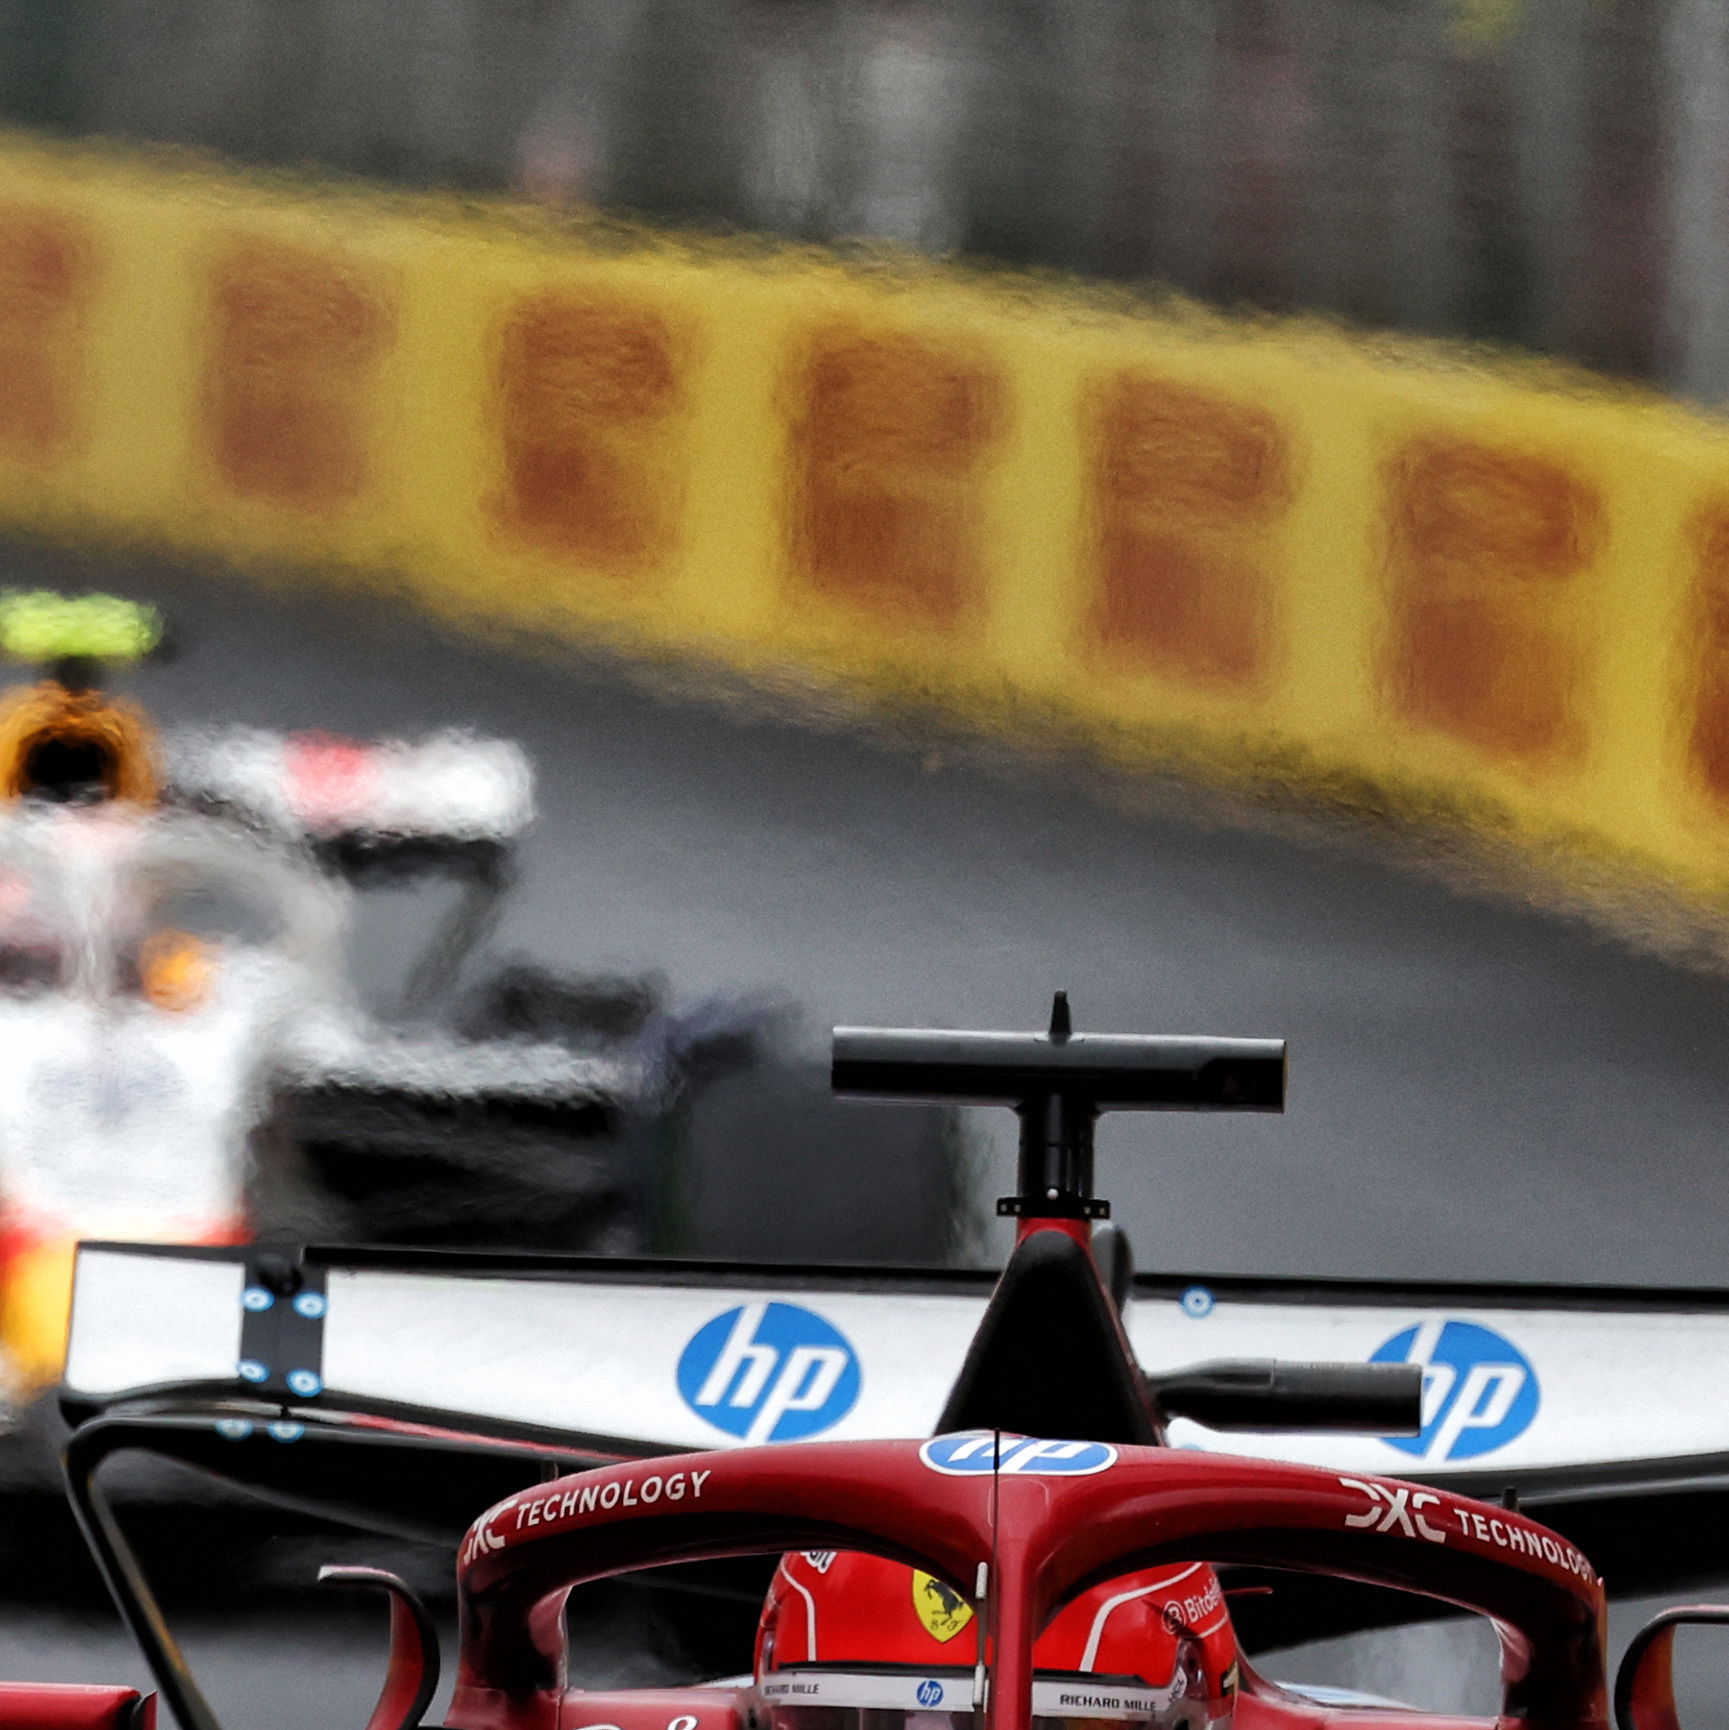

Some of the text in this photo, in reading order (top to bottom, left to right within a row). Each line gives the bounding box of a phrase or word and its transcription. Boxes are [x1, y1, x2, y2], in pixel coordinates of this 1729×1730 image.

[698, 1302, 849, 1441] hp
[1407, 1319, 1528, 1462] hp
[464, 1470, 710, 1566] XC TECHNOLOGY
[1338, 1477, 1447, 1544] DXC
[920, 1680, 941, 1706] hp
[1059, 1693, 1157, 1712] RICHARD MILLE
